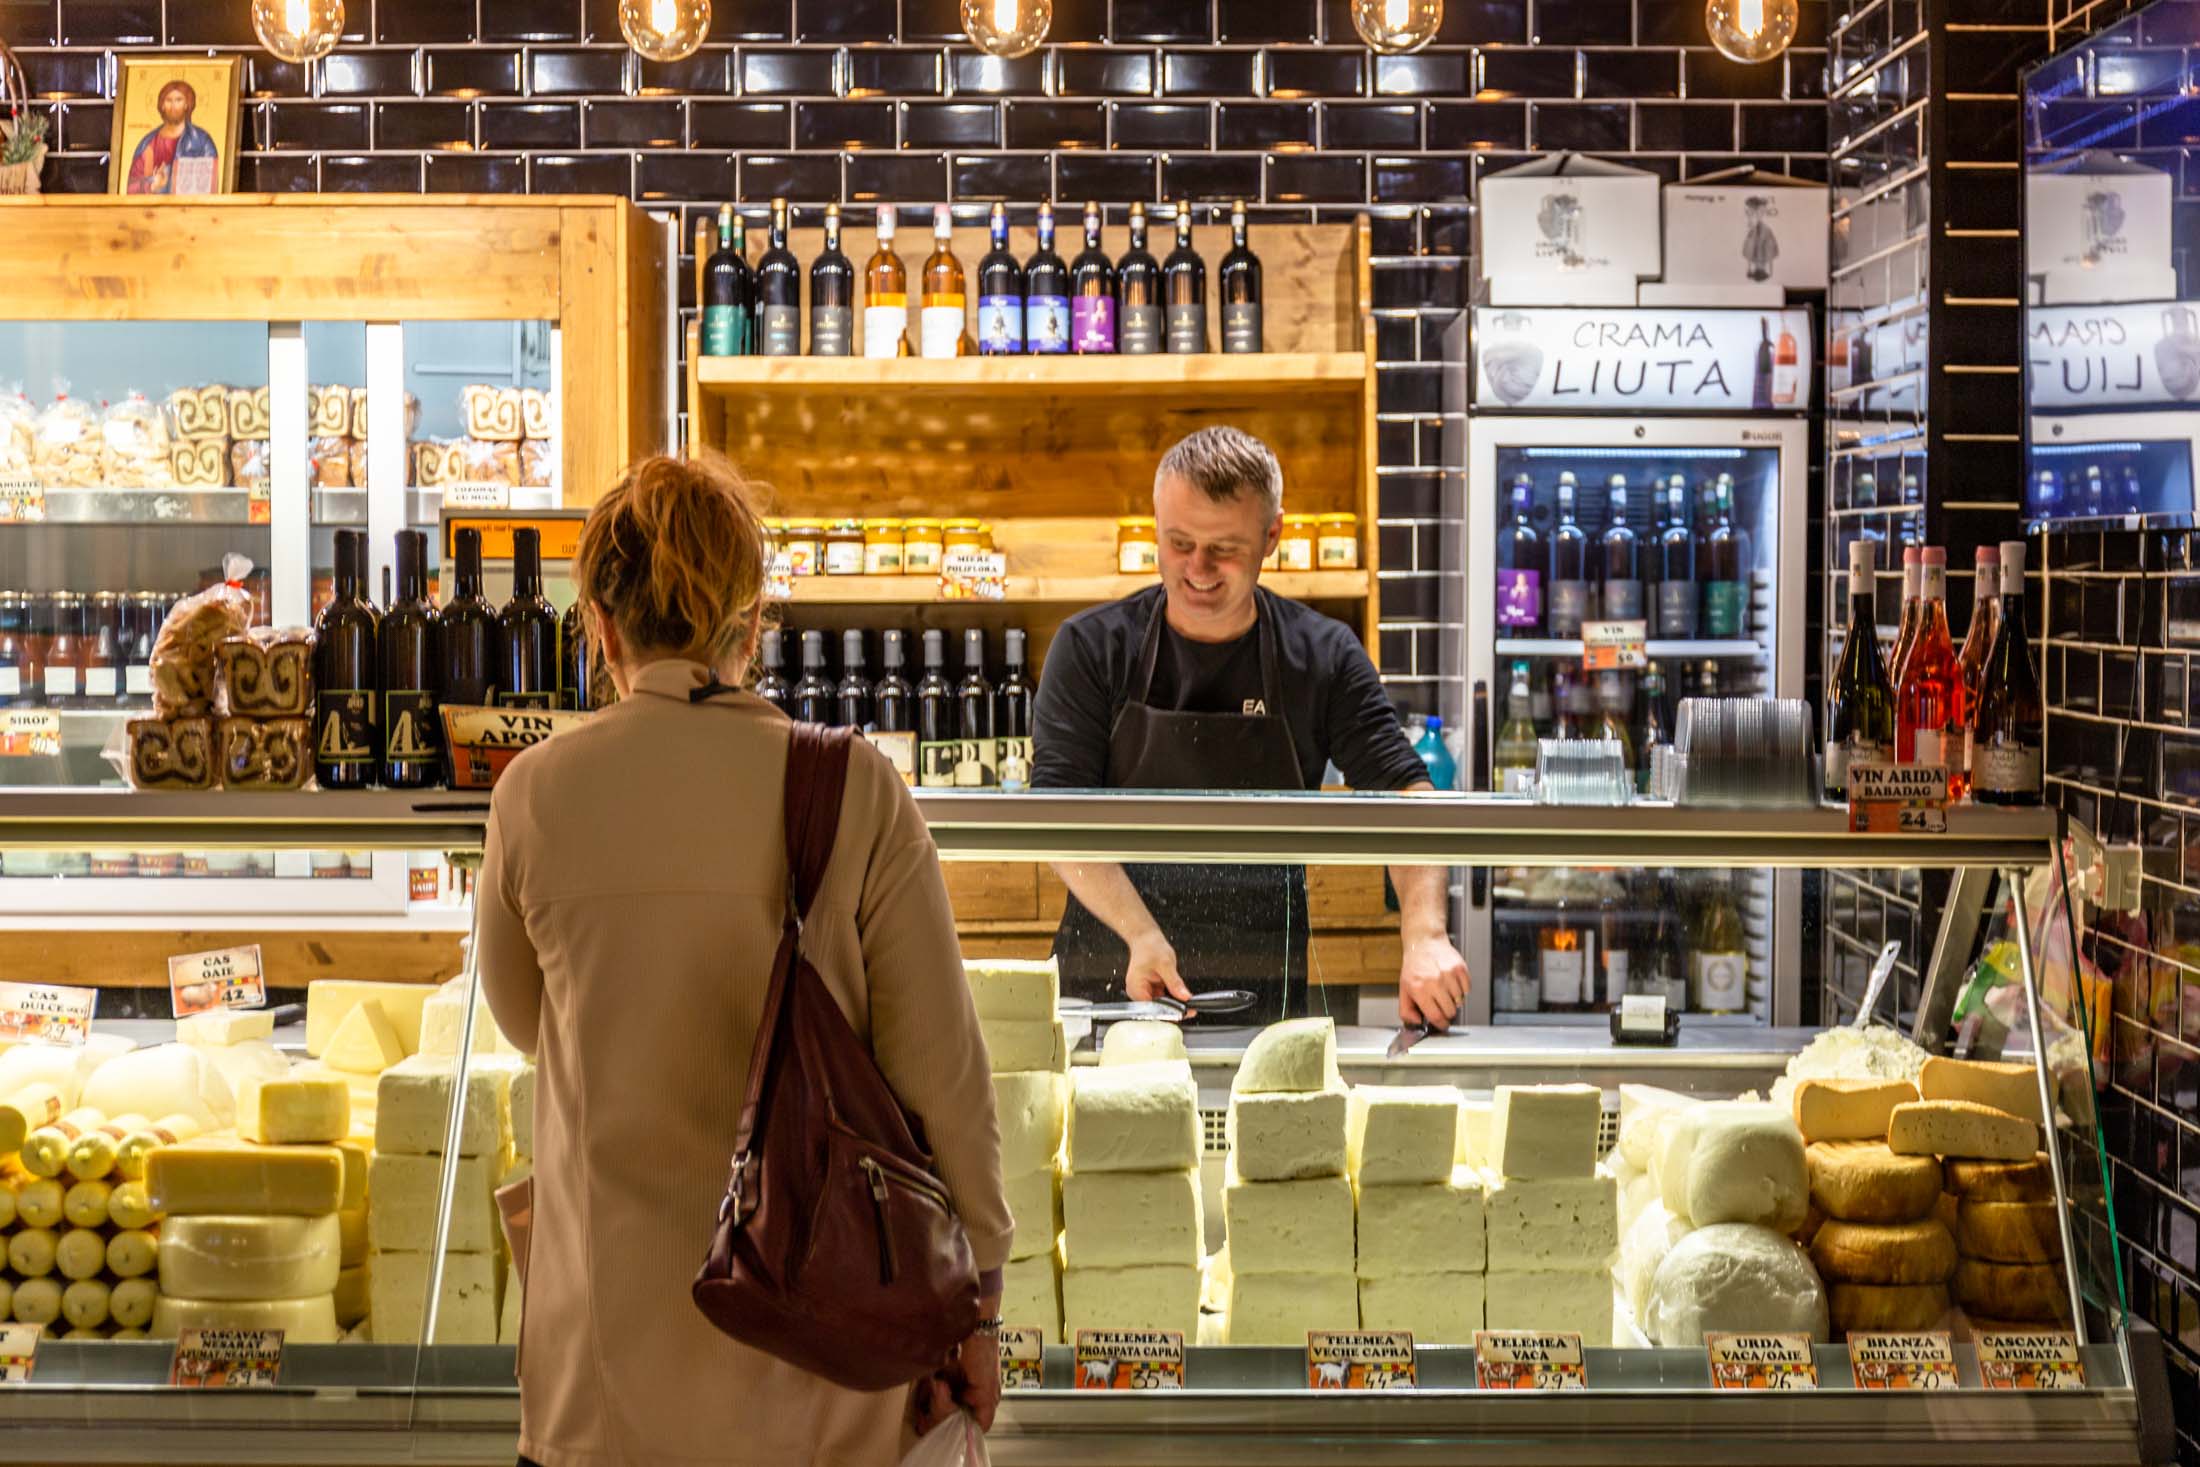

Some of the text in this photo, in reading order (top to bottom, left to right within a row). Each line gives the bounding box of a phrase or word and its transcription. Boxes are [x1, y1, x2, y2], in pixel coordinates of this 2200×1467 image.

[1573, 321, 1713, 349] CRAMA
[1553, 359, 1732, 397] LIUTA
[1604, 626, 1624, 634] VIN
[10, 716, 49, 725] SIROP
[499, 714, 552, 731] VIN
[1853, 768, 1944, 783] VIN ARIDA
[1864, 786, 1932, 797] BABADAG
[203, 955, 231, 967] CAS
[202, 967, 234, 979] OAIE
[29, 991, 58, 1001] CAS
[21, 1000, 64, 1012] DULCE
[1094, 1332, 1169, 1344] TELEMEA
[1327, 1335, 1395, 1345] TELEMEA
[1490, 1337, 1567, 1348] TELEMEA
[1736, 1338, 1783, 1348] URDA
[1866, 1337, 1935, 1348] BRANZA
[1079, 1346, 1180, 1358] PROASPATA CAPRA
[1313, 1347, 1409, 1357] VECHE CAPRA
[1512, 1350, 1549, 1361] VACA
[1721, 1350, 1802, 1361] VACA/OAIE
[1860, 1350, 1945, 1361] DULCE VACI
[1995, 1349, 2063, 1359] AFUMATA
[1131, 1369, 1159, 1389] 35
